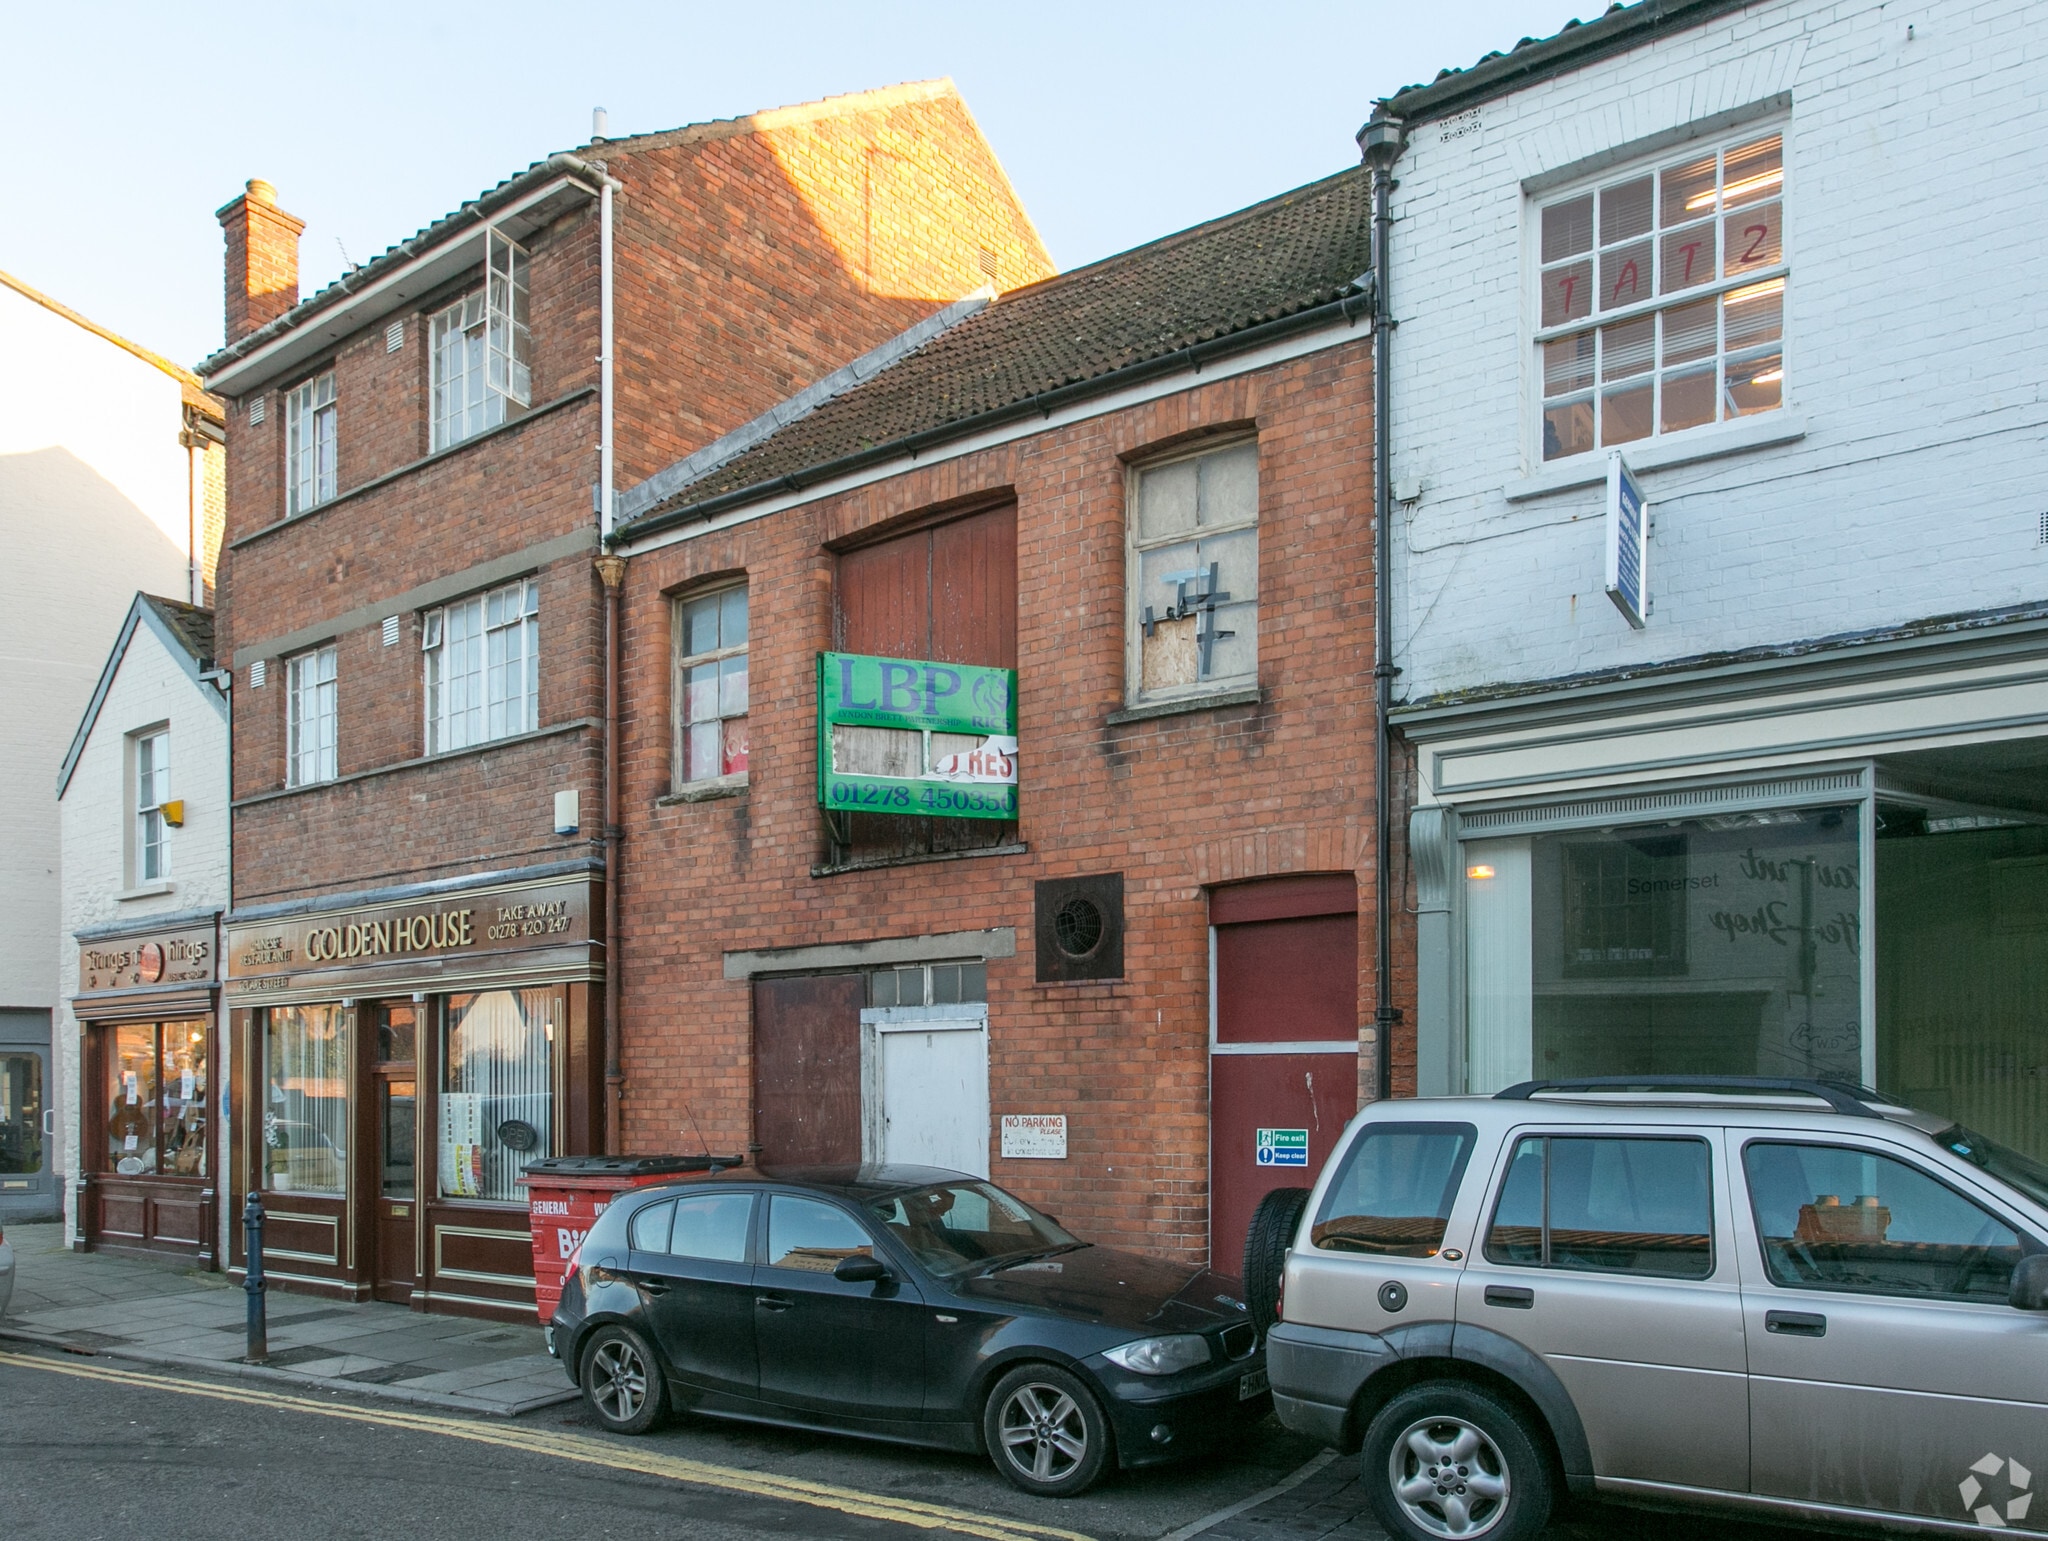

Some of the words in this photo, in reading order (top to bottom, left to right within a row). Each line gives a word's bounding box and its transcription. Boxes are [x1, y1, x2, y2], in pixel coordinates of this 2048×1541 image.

[838, 658, 962, 715] LBP
[838, 710, 873, 720] LYNDON
[876, 712, 903, 722] BRETT
[905, 715, 961, 727] PARTNERSHIP
[972, 715, 1012, 729] RICS
[832, 781, 910, 807] 01278
[920, 787, 1017, 813] 450350
[1628, 872, 1720, 895] Somerset
[497, 905, 525, 922] TAKE
[527, 900, 563, 918] AWAY
[305, 921, 390, 962] GOLDEN
[396, 909, 473, 951] HOUSE
[488, 922, 518, 940] 01278
[521, 919, 544, 936] 420
[548, 916, 568, 933] 247
[1005, 1116, 1020, 1128] NO
[1021, 1116, 1063, 1128] PARKING
[1291, 1134, 1304, 1142] exit
[1275, 1152, 1290, 1160] Keep
[533, 1201, 569, 1215] GENERAL
